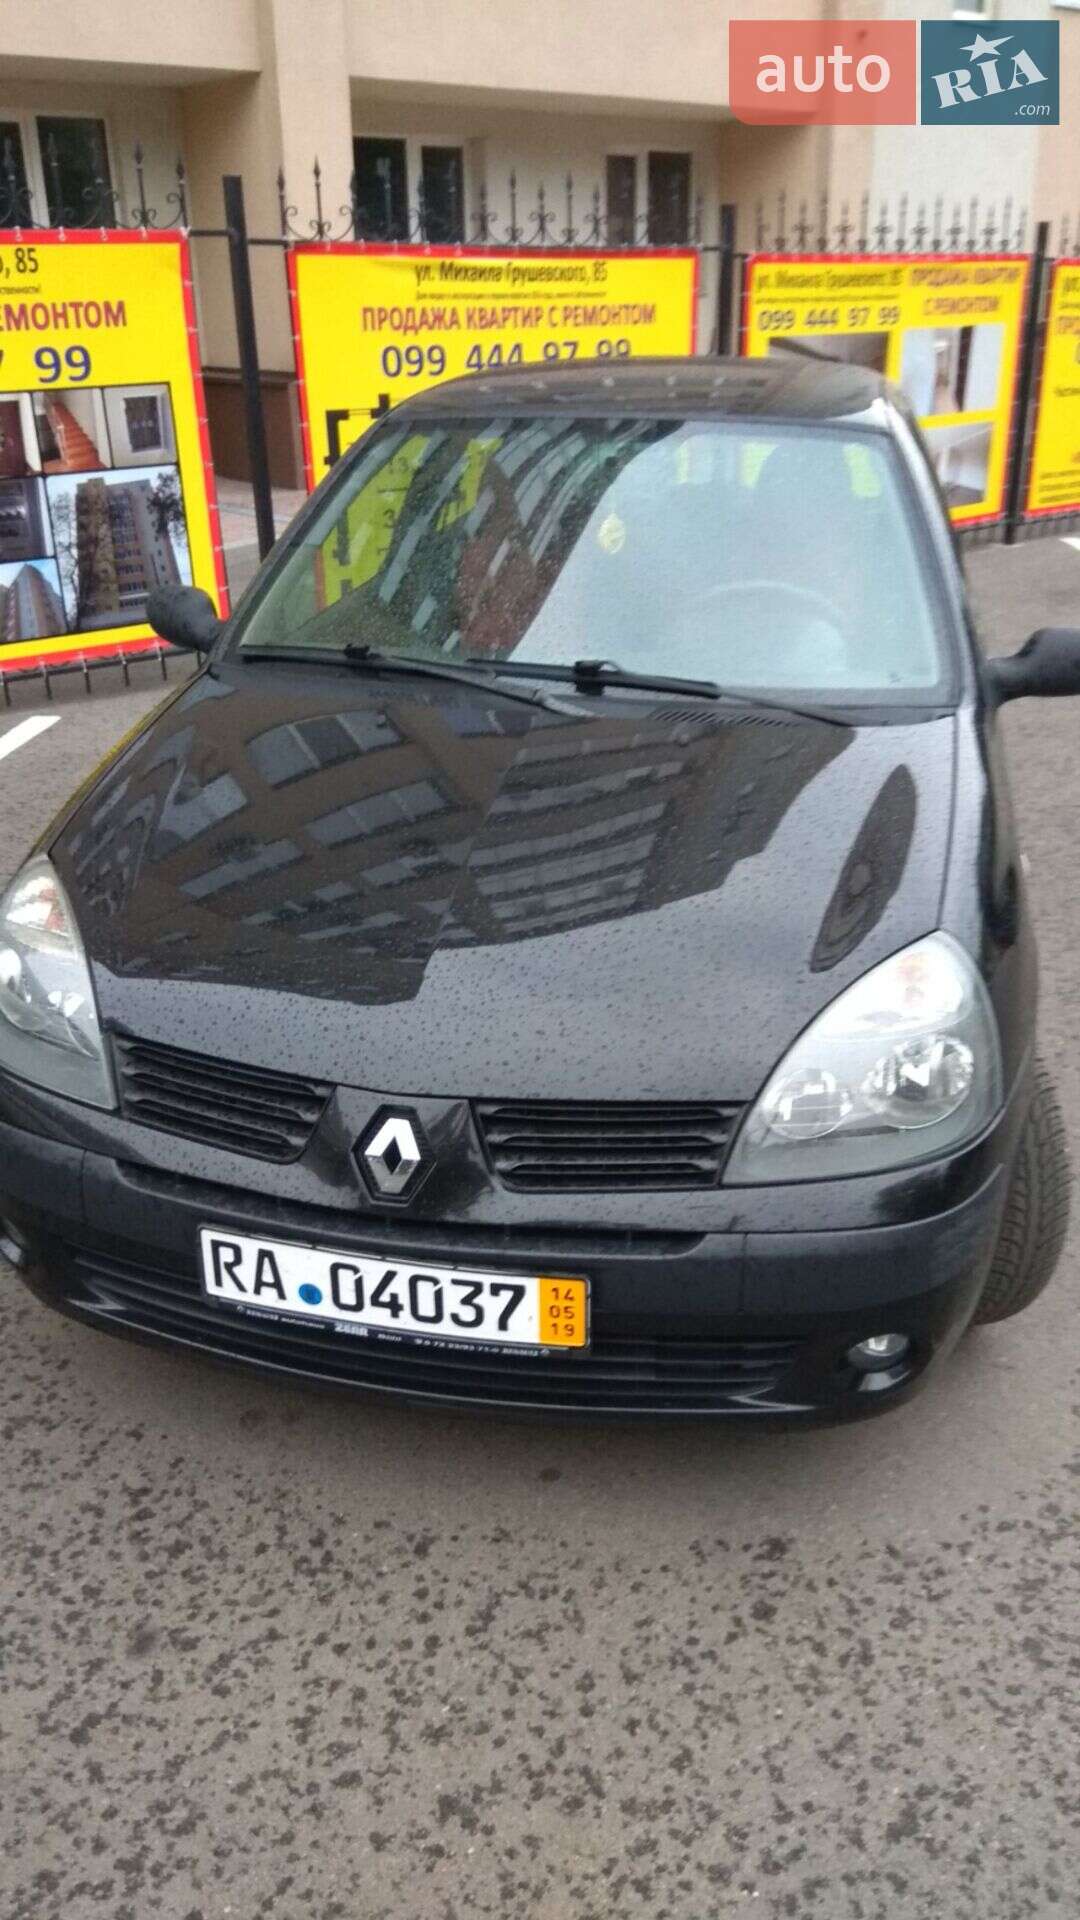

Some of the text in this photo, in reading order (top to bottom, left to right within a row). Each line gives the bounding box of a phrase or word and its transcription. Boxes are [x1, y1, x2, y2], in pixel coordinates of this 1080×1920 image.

[14, 247, 39, 273] 85
[439, 261, 501, 282] Михаила
[362, 303, 657, 335] ПРОДАЖА КВАРТИР С РЕМОНТОМ
[34, 344, 92, 384] 99
[381, 344, 447, 378] 099
[465, 342, 524, 370] 444
[209, 1238, 527, 1332] RA 04037
[551, 1286, 575, 1301] 14
[548, 1304, 576, 1320] 05
[551, 1322, 576, 1337] 19
